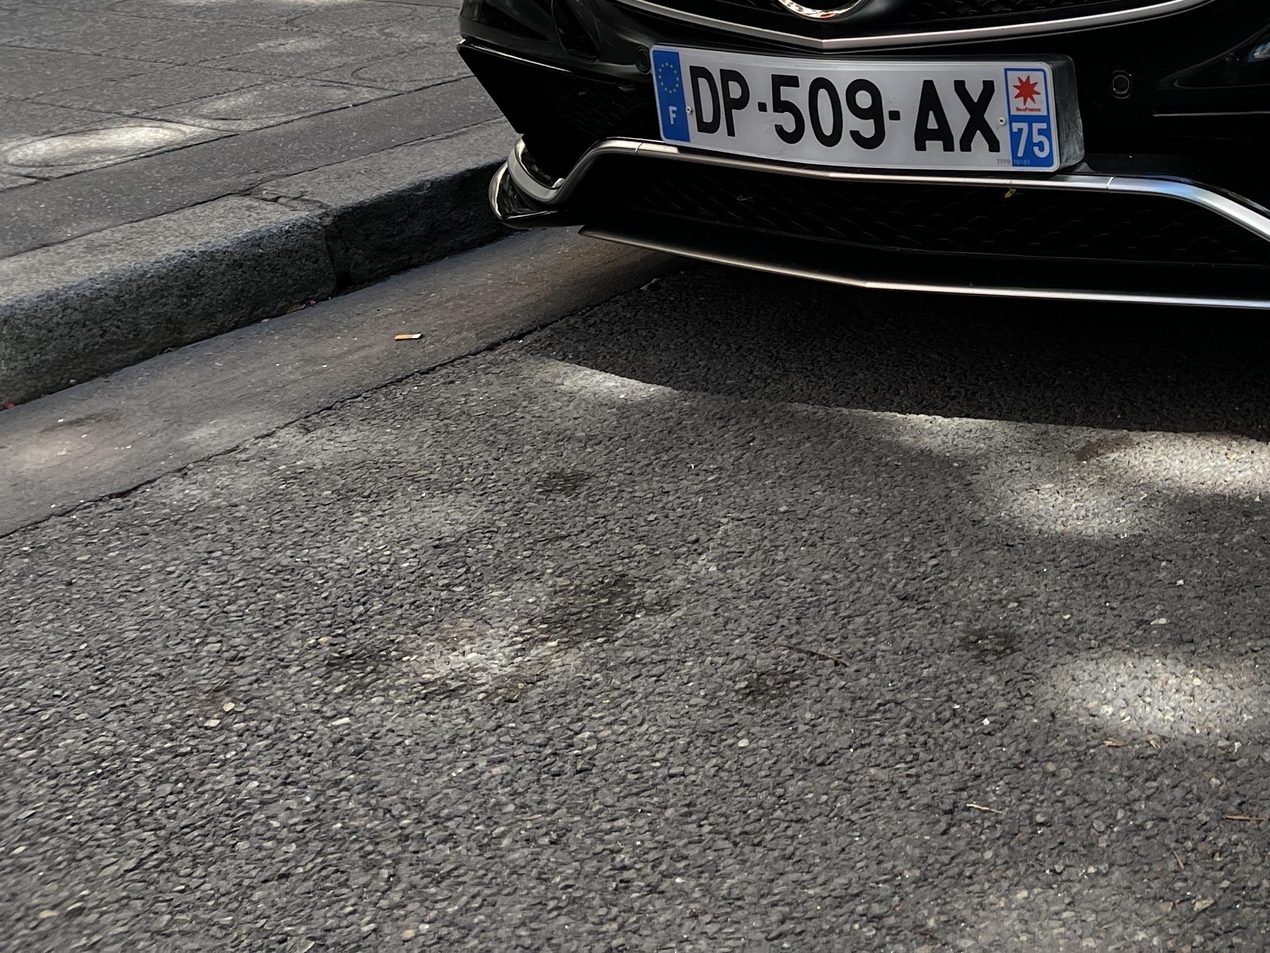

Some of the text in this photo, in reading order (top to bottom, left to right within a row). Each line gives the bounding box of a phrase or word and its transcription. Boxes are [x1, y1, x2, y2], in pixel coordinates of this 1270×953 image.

[668, 105, 678, 125] F
[689, 65, 1001, 153] DP-509-AX
[1011, 122, 1051, 158] 75
